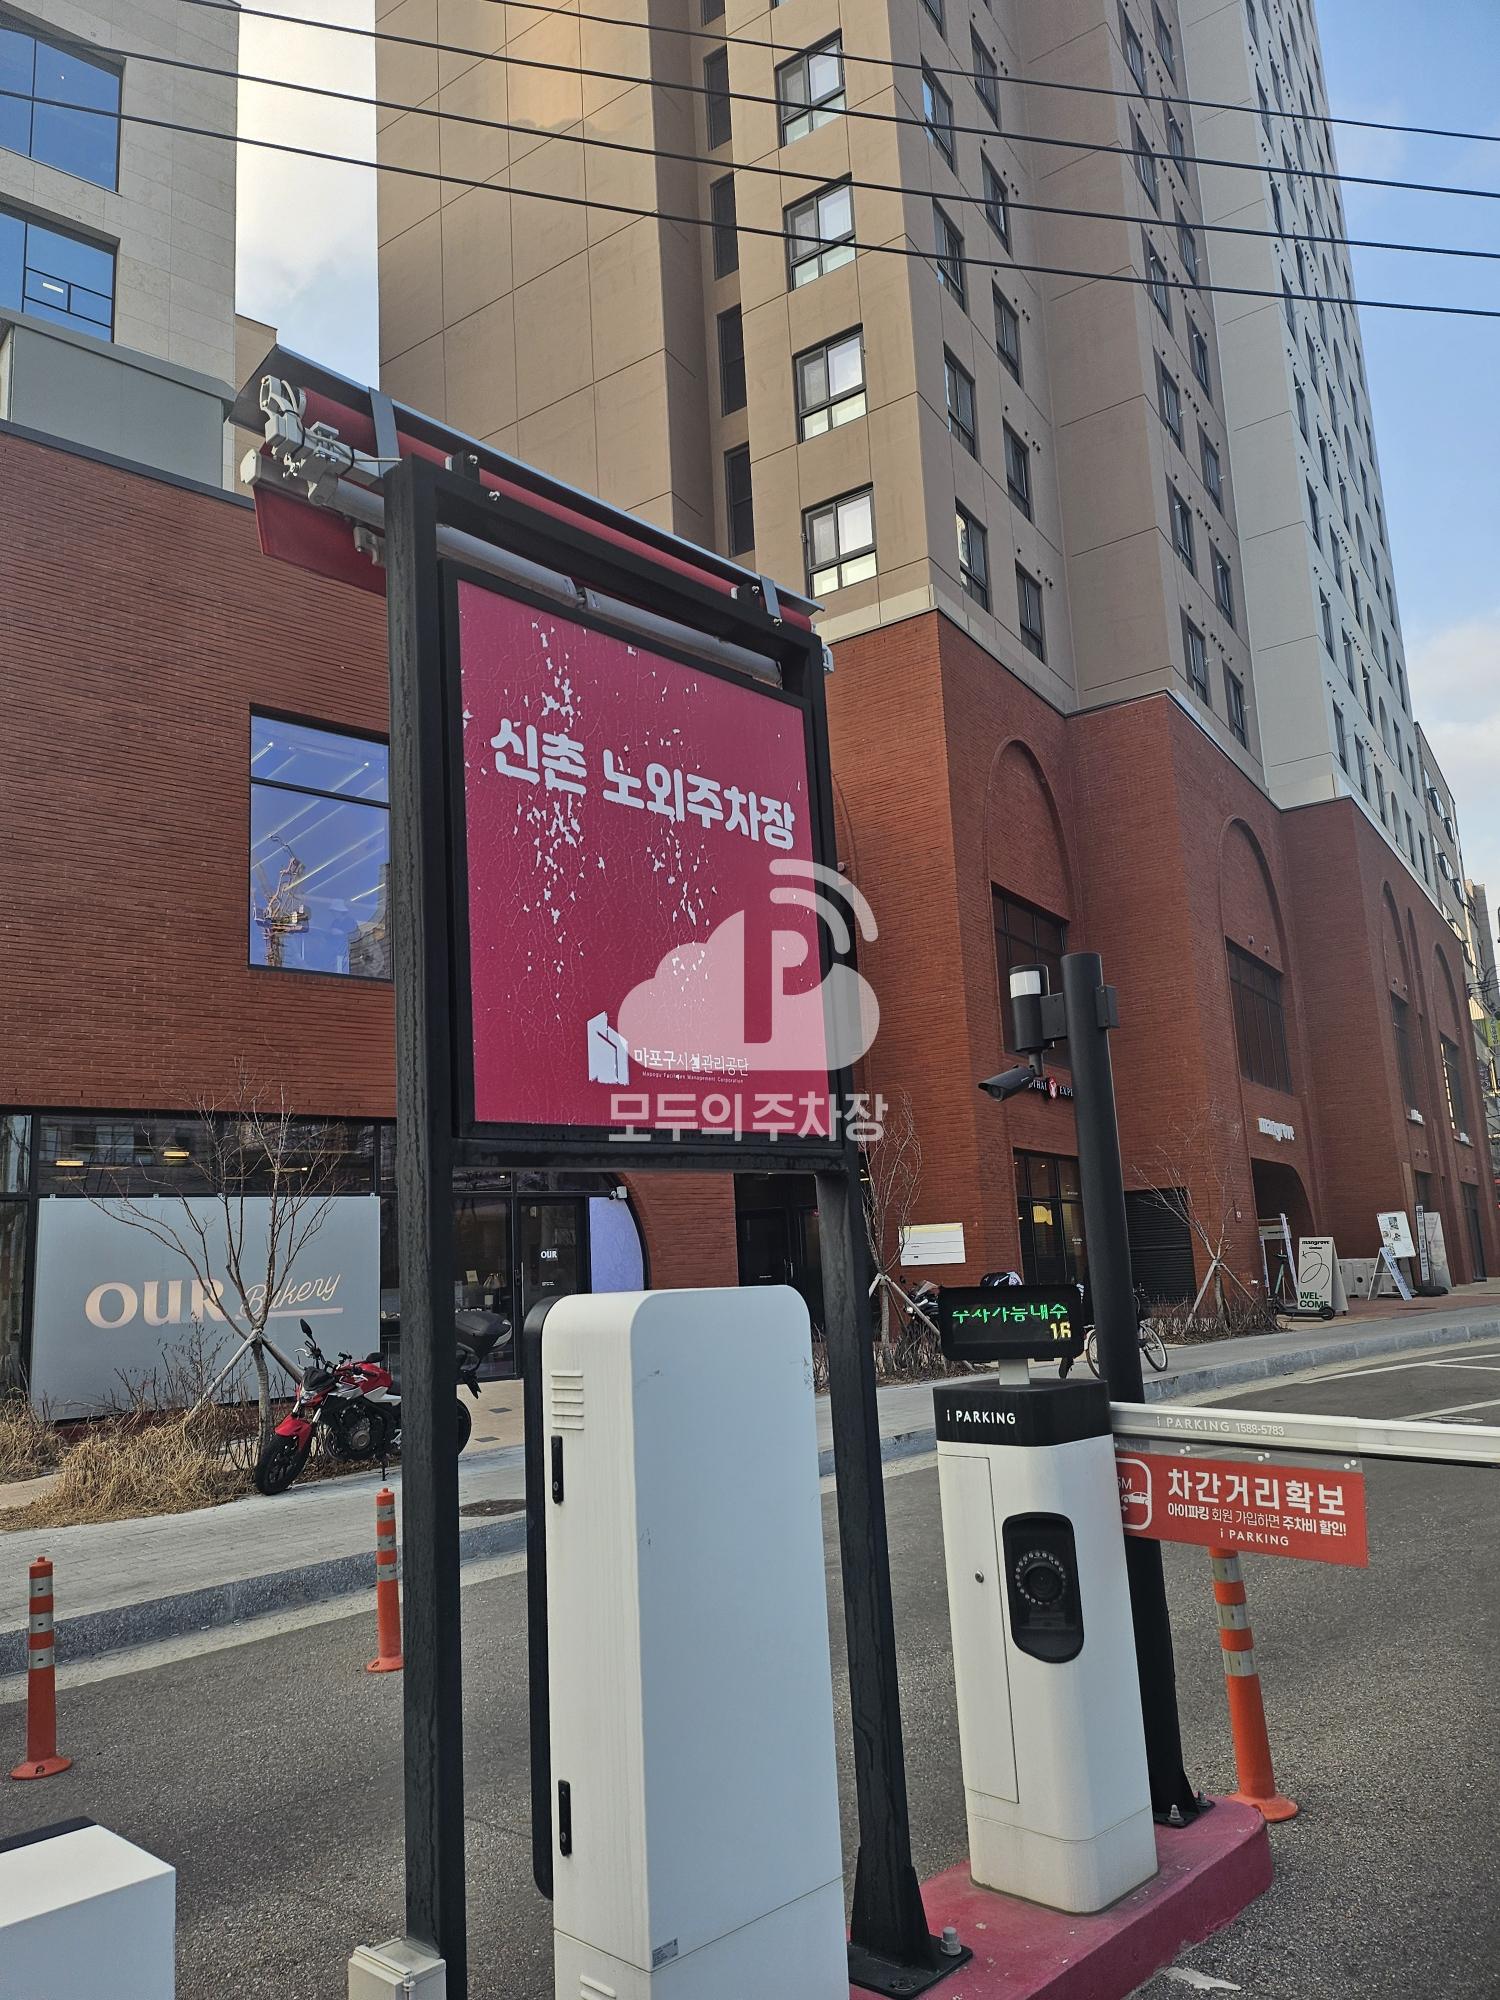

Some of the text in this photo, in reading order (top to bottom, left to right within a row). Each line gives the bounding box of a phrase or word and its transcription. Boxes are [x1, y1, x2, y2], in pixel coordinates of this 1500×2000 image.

[490, 718, 796, 850] 신촌 노외주차장
[633, 1047, 749, 1077] 마포구시설관리공단
[663, 1071, 686, 1081] Facilies
[687, 1073, 716, 1083] Management
[540, 1250, 558, 1259] OUR
[85, 1278, 229, 1329] OUR
[1300, 1291, 1323, 1300] WEL-
[955, 1410, 1016, 1425] PARKING
[1166, 1417, 1230, 1432] PARKING
[1235, 1422, 1285, 1436] 1588-5783
[1167, 1468, 1345, 1516] 차간거리확보
[1167, 1502, 1347, 1537] 아이파킹 회원 가입하면 주차비 할인!
[1229, 1530, 1289, 1546] PARKING
